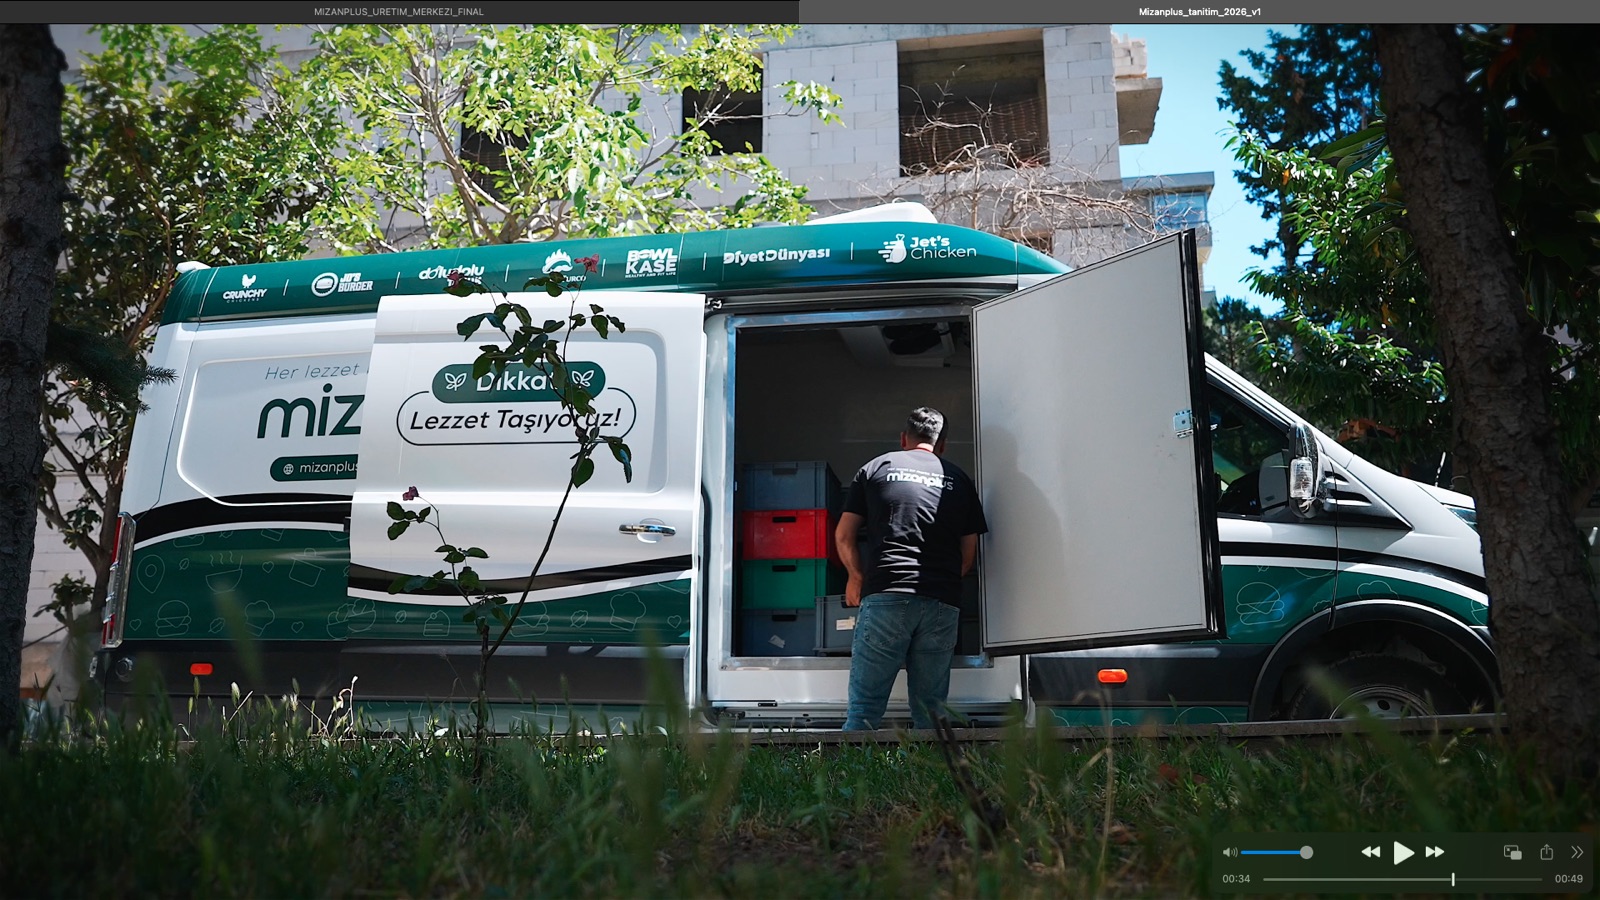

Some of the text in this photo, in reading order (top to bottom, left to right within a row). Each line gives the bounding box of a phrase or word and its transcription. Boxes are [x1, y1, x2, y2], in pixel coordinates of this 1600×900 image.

[909, 235, 950, 248] Jet's
[627, 248, 678, 261] BOWL
[910, 246, 977, 260] Chicken
[625, 258, 678, 274] KASE
[337, 281, 373, 292] BURGER
[222, 288, 268, 300] CRUNCHY
[265, 363, 360, 380] Her lezzet
[257, 383, 365, 439] miz
[409, 410, 490, 430] Lezzet
